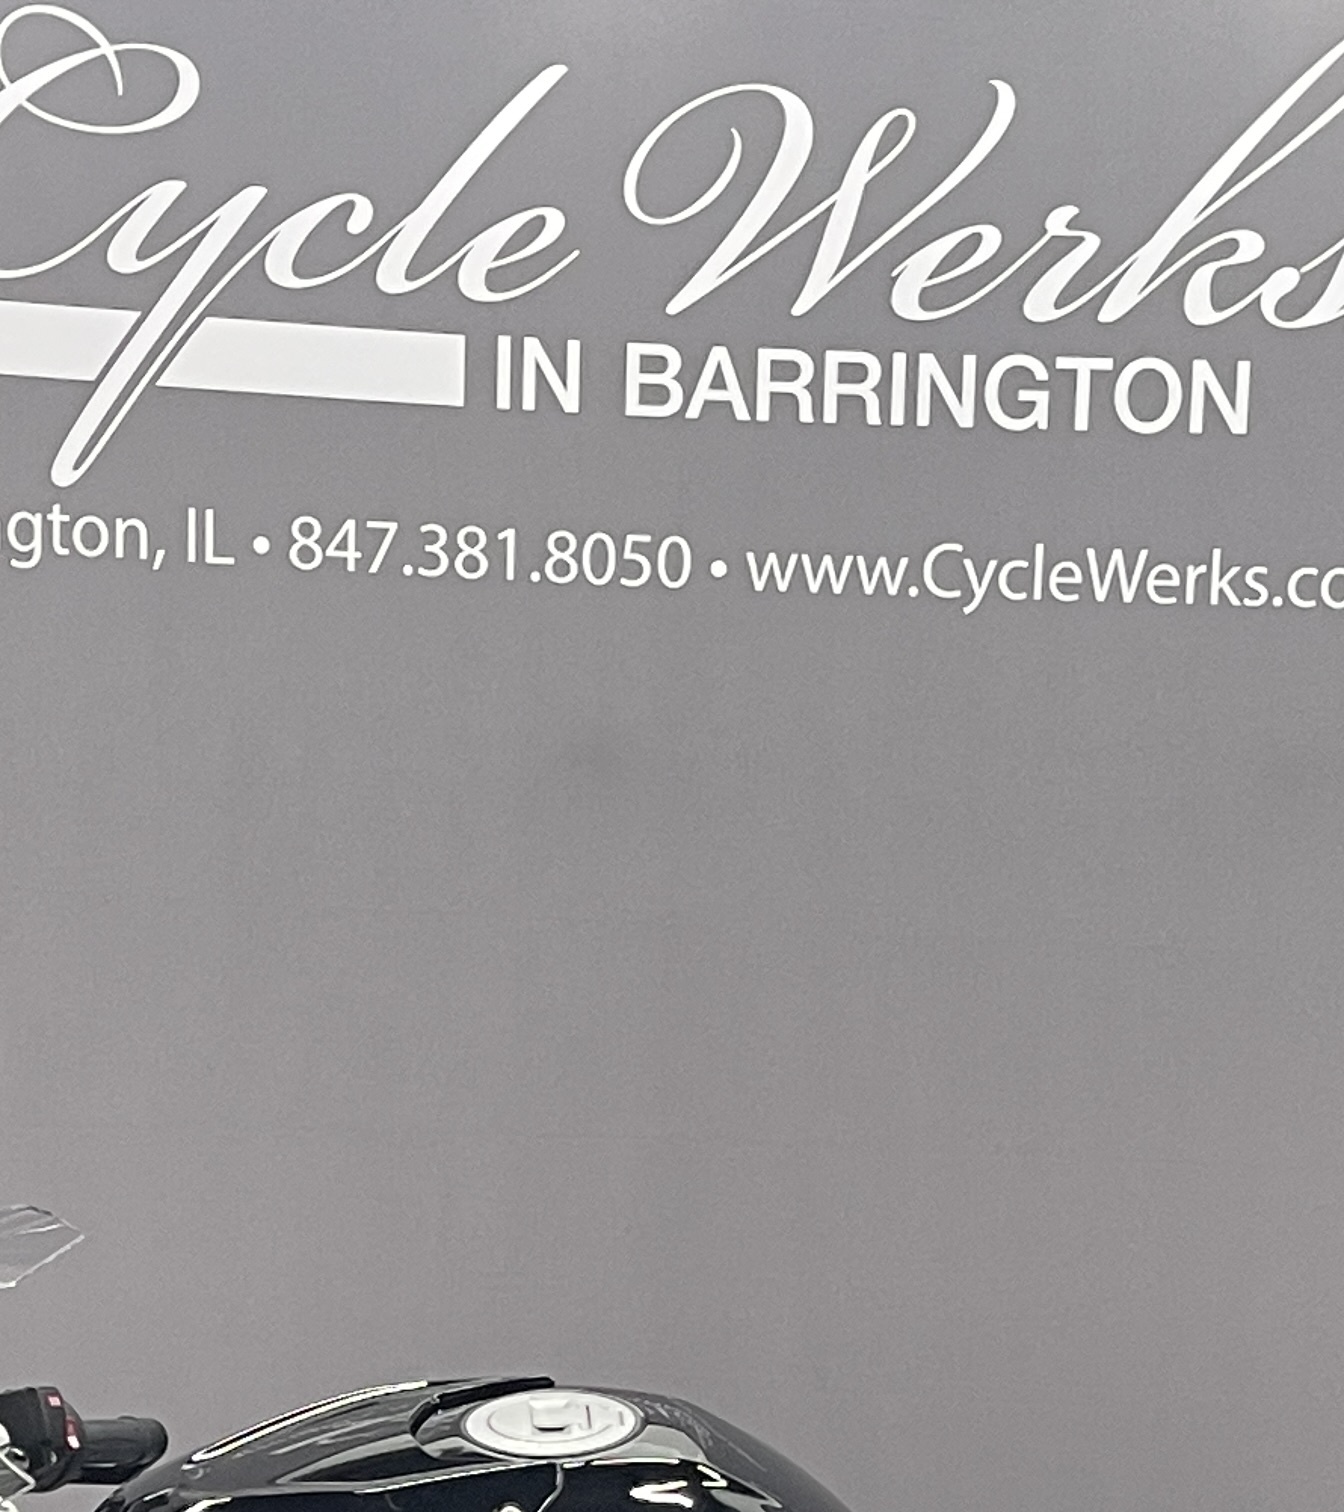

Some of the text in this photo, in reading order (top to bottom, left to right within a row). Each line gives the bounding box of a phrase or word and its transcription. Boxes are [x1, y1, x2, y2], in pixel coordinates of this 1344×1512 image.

[495, 334, 1252, 435] IN BARRINGTON
[186, 507, 235, 565] IL
[289, 515, 692, 589] 847.381.8050
